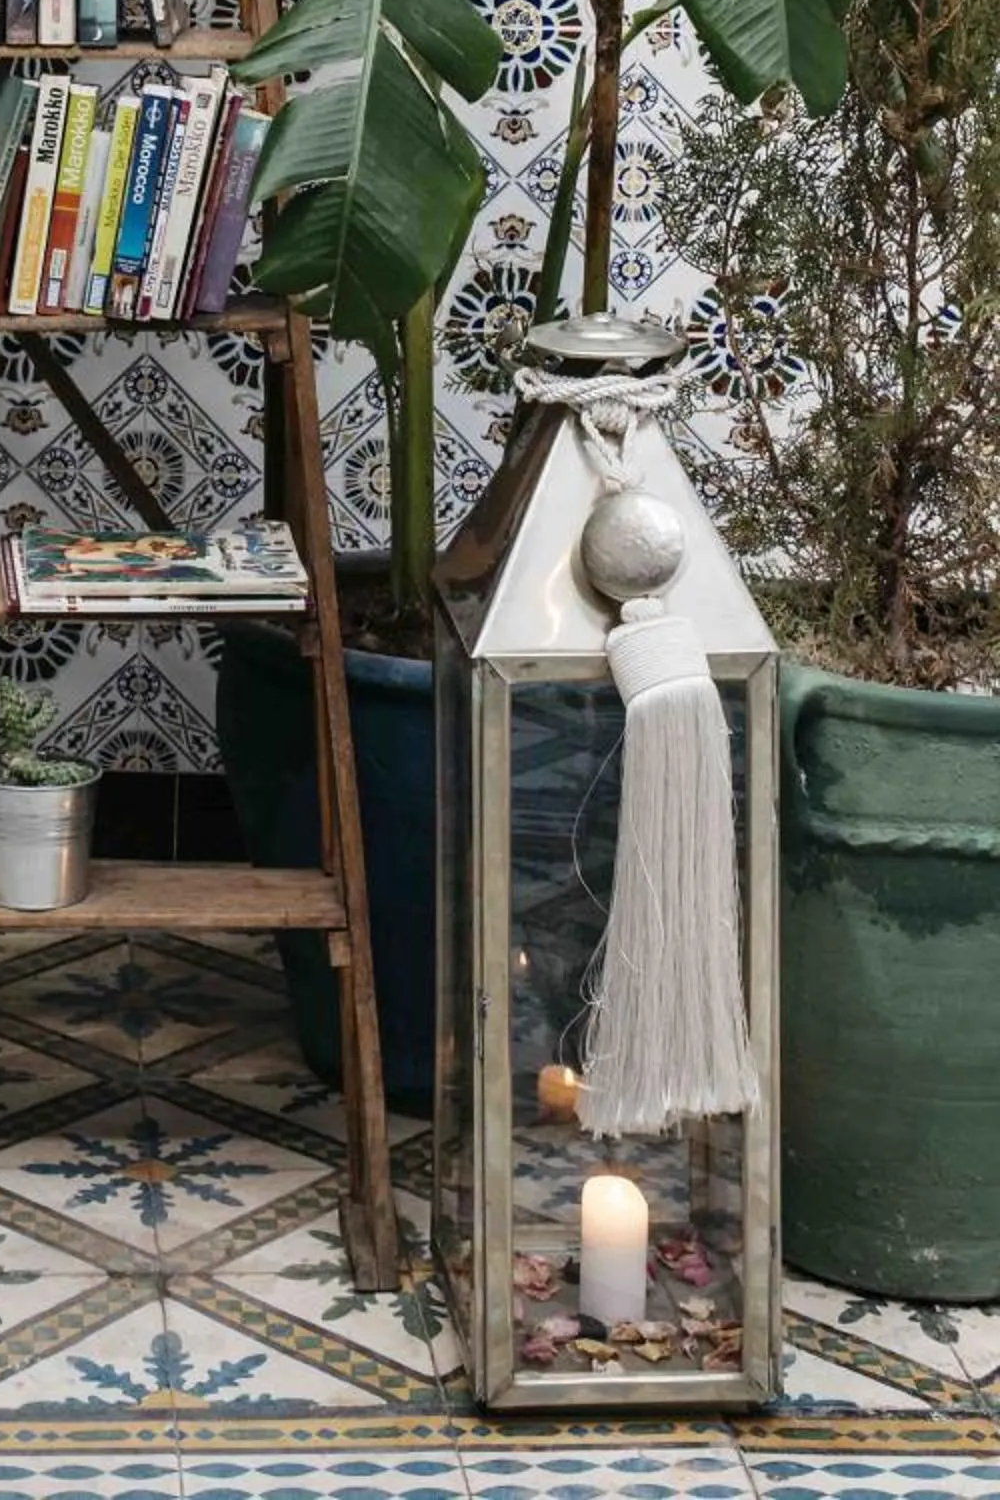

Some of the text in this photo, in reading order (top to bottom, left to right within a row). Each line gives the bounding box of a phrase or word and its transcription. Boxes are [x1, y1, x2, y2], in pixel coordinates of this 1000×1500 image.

[36, 87, 64, 165] Marokko
[61, 99, 91, 189] Marokko
[177, 119, 207, 198] Marokko
[133, 134, 159, 205] Morocco
